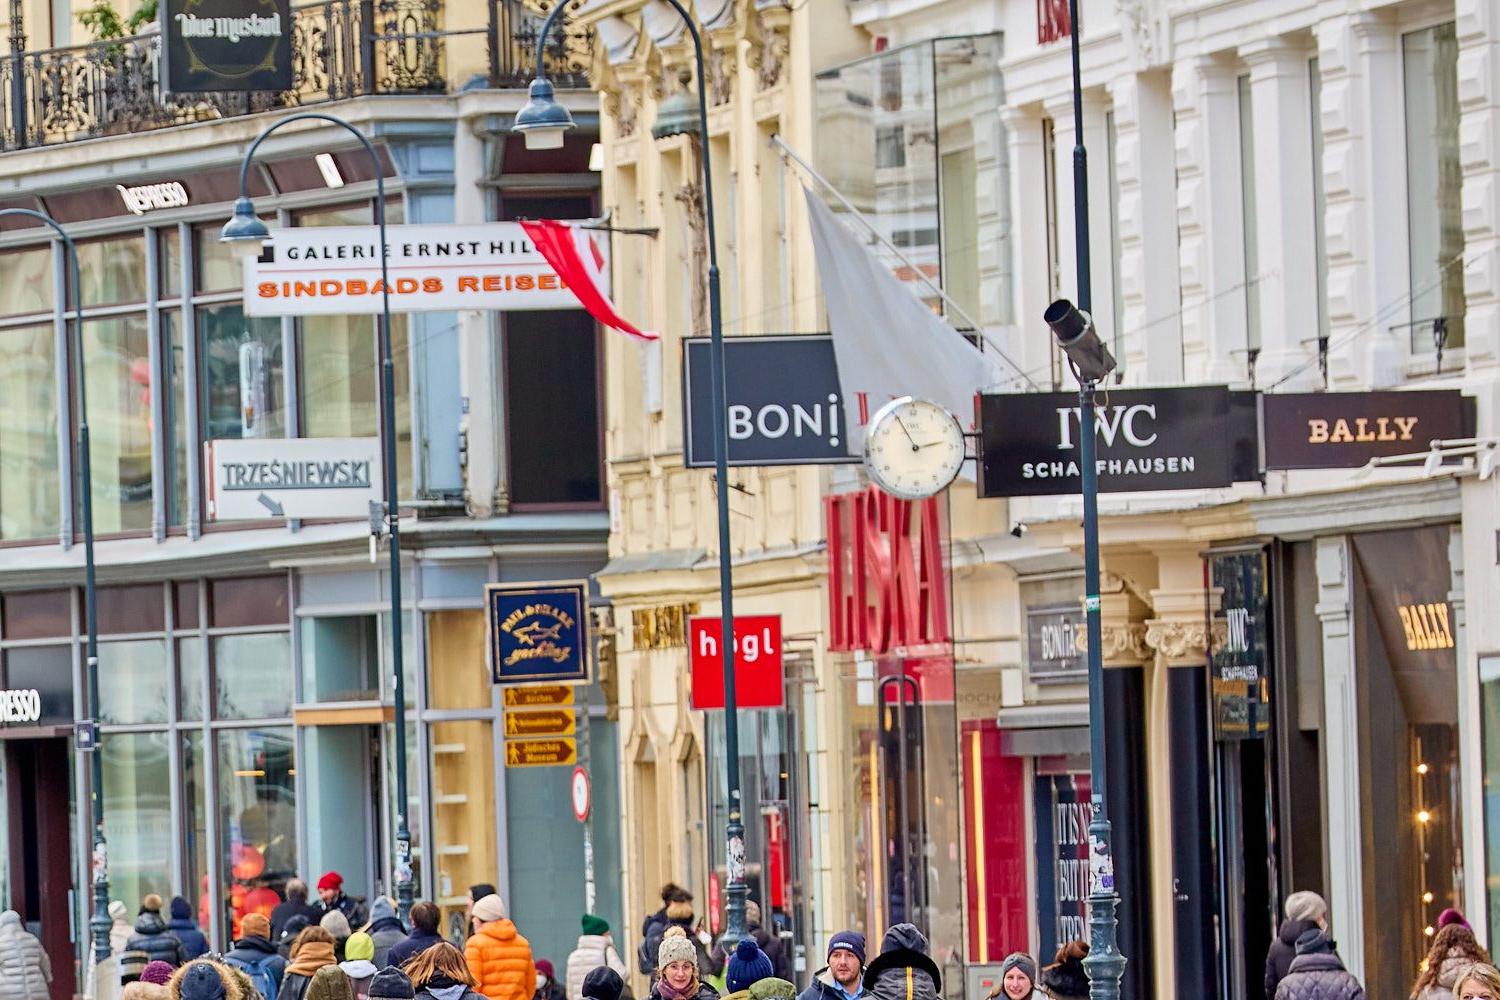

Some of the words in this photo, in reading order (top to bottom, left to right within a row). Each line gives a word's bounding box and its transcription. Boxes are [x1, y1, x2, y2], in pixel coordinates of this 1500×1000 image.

[215, 12, 282, 43] mustard
[116, 182, 189, 216] NESPRESSO
[287, 244, 391, 260] GALERIE
[403, 242, 480, 257] ERNST
[490, 240, 538, 254] HIL
[258, 276, 444, 298] SINDBADS
[1056, 404, 1158, 450] IWC
[1308, 416, 1418, 443] BALLY
[222, 457, 372, 487] TRZEŚNIEWSKI
[1022, 456, 1196, 479] SCHAFHAUSEN
[1398, 602, 1454, 650] BALLY
[1059, 859, 1079, 901] BUT
